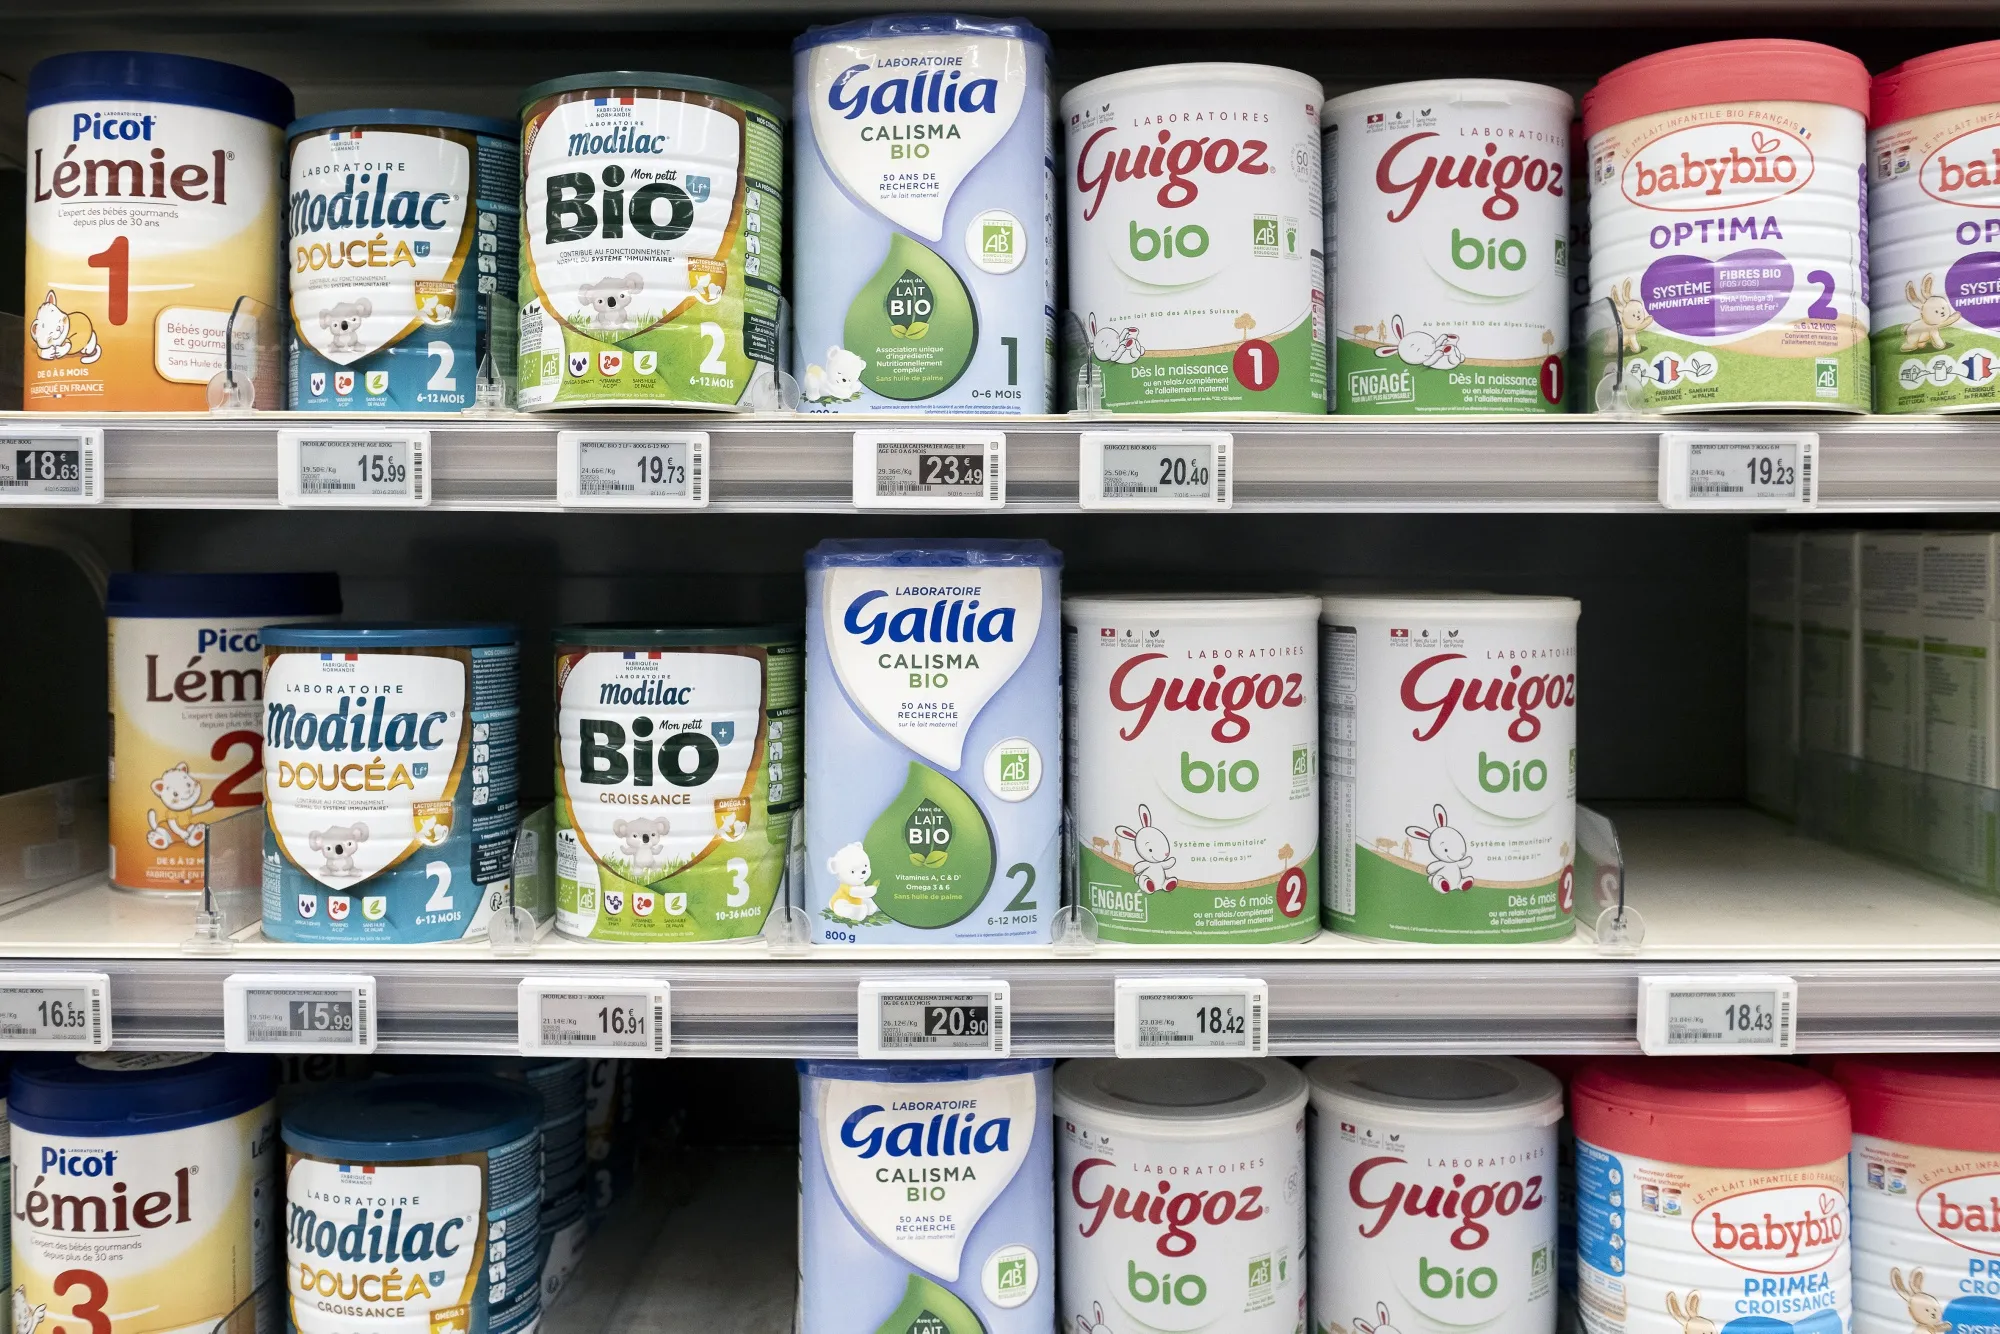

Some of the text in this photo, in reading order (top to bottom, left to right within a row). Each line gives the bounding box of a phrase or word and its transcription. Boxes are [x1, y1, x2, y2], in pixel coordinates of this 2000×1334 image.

[878, 57, 963, 68] LABORATOIRE
[828, 63, 998, 120] Gallia
[73, 112, 154, 141] Picot
[1134, 111, 1270, 127] LABORATOIRES
[1667, 110, 1725, 128] INFANTILE
[1748, 110, 1799, 131] FRANÇAIS
[567, 126, 666, 157] modilac
[860, 124, 962, 141] CALISMA
[890, 143, 930, 159] BIO
[35, 144, 227, 205] Lémiel
[302, 162, 405, 178] LABORATOIRE
[631, 169, 678, 183] Mon petit
[1077, 126, 1269, 221] Guigoz
[1376, 131, 1565, 223] Guigoz
[1635, 146, 1798, 197] babybio
[880, 182, 940, 190] RECHERCHE
[58, 207, 179, 219] L'expert bébés gourmands
[130, 218, 142, 226] 30
[1129, 220, 1210, 262] bio
[1650, 216, 1784, 249] OPTIMA
[296, 232, 416, 274] DOUCÉA
[605, 248, 671, 256] FONCTIONNEMENT
[1451, 228, 1527, 271] bio
[88, 236, 130, 326] 1
[1720, 268, 1781, 280] FIBRES BIO
[896, 286, 925, 297] LAIT
[1653, 281, 1712, 299] SYSTÈME
[1807, 270, 1839, 320] 2
[890, 299, 931, 316] BIO
[699, 322, 727, 375] 2
[427, 341, 457, 391] 2
[1000, 336, 1018, 386] 1
[1131, 364, 1229, 379] Dès la naissance
[1248, 348, 1263, 385] 1
[66, 368, 89, 376] MOIS
[689, 376, 734, 389] 6-12 MOIS
[1351, 369, 1410, 396] ENGAGÉ
[1548, 363, 1558, 399] 1
[71, 384, 104, 392] FRANCE
[417, 393, 465, 404] 6-12 MOIS
[971, 389, 1021, 399] 0-6 MOIS
[1198, 385, 1229, 393] maternel
[895, 586, 982, 596] LABORATOIRE
[843, 589, 1016, 646] Gallia
[878, 654, 980, 670] CALISMA
[1188, 647, 1304, 659] LABORATOIRES
[286, 684, 404, 694] LABORATOIRE
[909, 673, 949, 689] BIO
[599, 680, 692, 706] modilac
[1109, 652, 1303, 743] Guigoz
[1400, 653, 1575, 743] Guigoz
[267, 695, 448, 752] modilac
[659, 719, 703, 733] Mon petit
[211, 731, 264, 808] 2
[278, 755, 414, 792] DOUCÉA
[1181, 751, 1259, 794] bio
[1478, 751, 1548, 793] bio
[599, 793, 691, 805] CROISSANCE
[719, 800, 741, 809] OMÉGA
[915, 816, 944, 825] LAIT
[909, 828, 950, 844] BIO
[425, 861, 454, 912] 2
[726, 858, 750, 907] 3
[1003, 862, 1037, 912] 2
[1091, 885, 1143, 912] ENGAGÉ
[1214, 894, 1273, 908] Dès 6 mois
[1285, 875, 1302, 912] 2
[415, 911, 461, 926] 6-12 MOIS
[715, 906, 762, 921] 10-36 MOIS
[987, 914, 1037, 926] 6-12 MOIS
[825, 930, 856, 944] 800 g
[892, 1100, 977, 1111] LABORATOIRE
[840, 1105, 1011, 1159] Gallia
[41, 1147, 118, 1177] Picot
[1134, 1158, 1264, 1175] LABORATOIRES
[1427, 1148, 1544, 1168] LABORATOIRES
[876, 1166, 976, 1183] CALISMA
[307, 1189, 420, 1206] LABORATOIRE
[907, 1187, 946, 1202] BIO
[1349, 1156, 1543, 1251] Guigoz
[1072, 1158, 1263, 1257] Guigoz
[290, 1203, 464, 1264] modilac
[896, 1223, 956, 1232] RECHERCHE
[1711, 1210, 1843, 1258] babybio
[93, 1241, 142, 1255] gourmands
[300, 1264, 431, 1302] DOUCÉA
[1127, 1259, 1207, 1306] bio
[1419, 1256, 1498, 1299] bio
[1744, 1271, 1830, 1298] PRIMEA
[53, 1269, 112, 1334] 3
[317, 1301, 405, 1318] CROISSANCE
[1734, 1290, 1837, 1315] CROISSANCE
